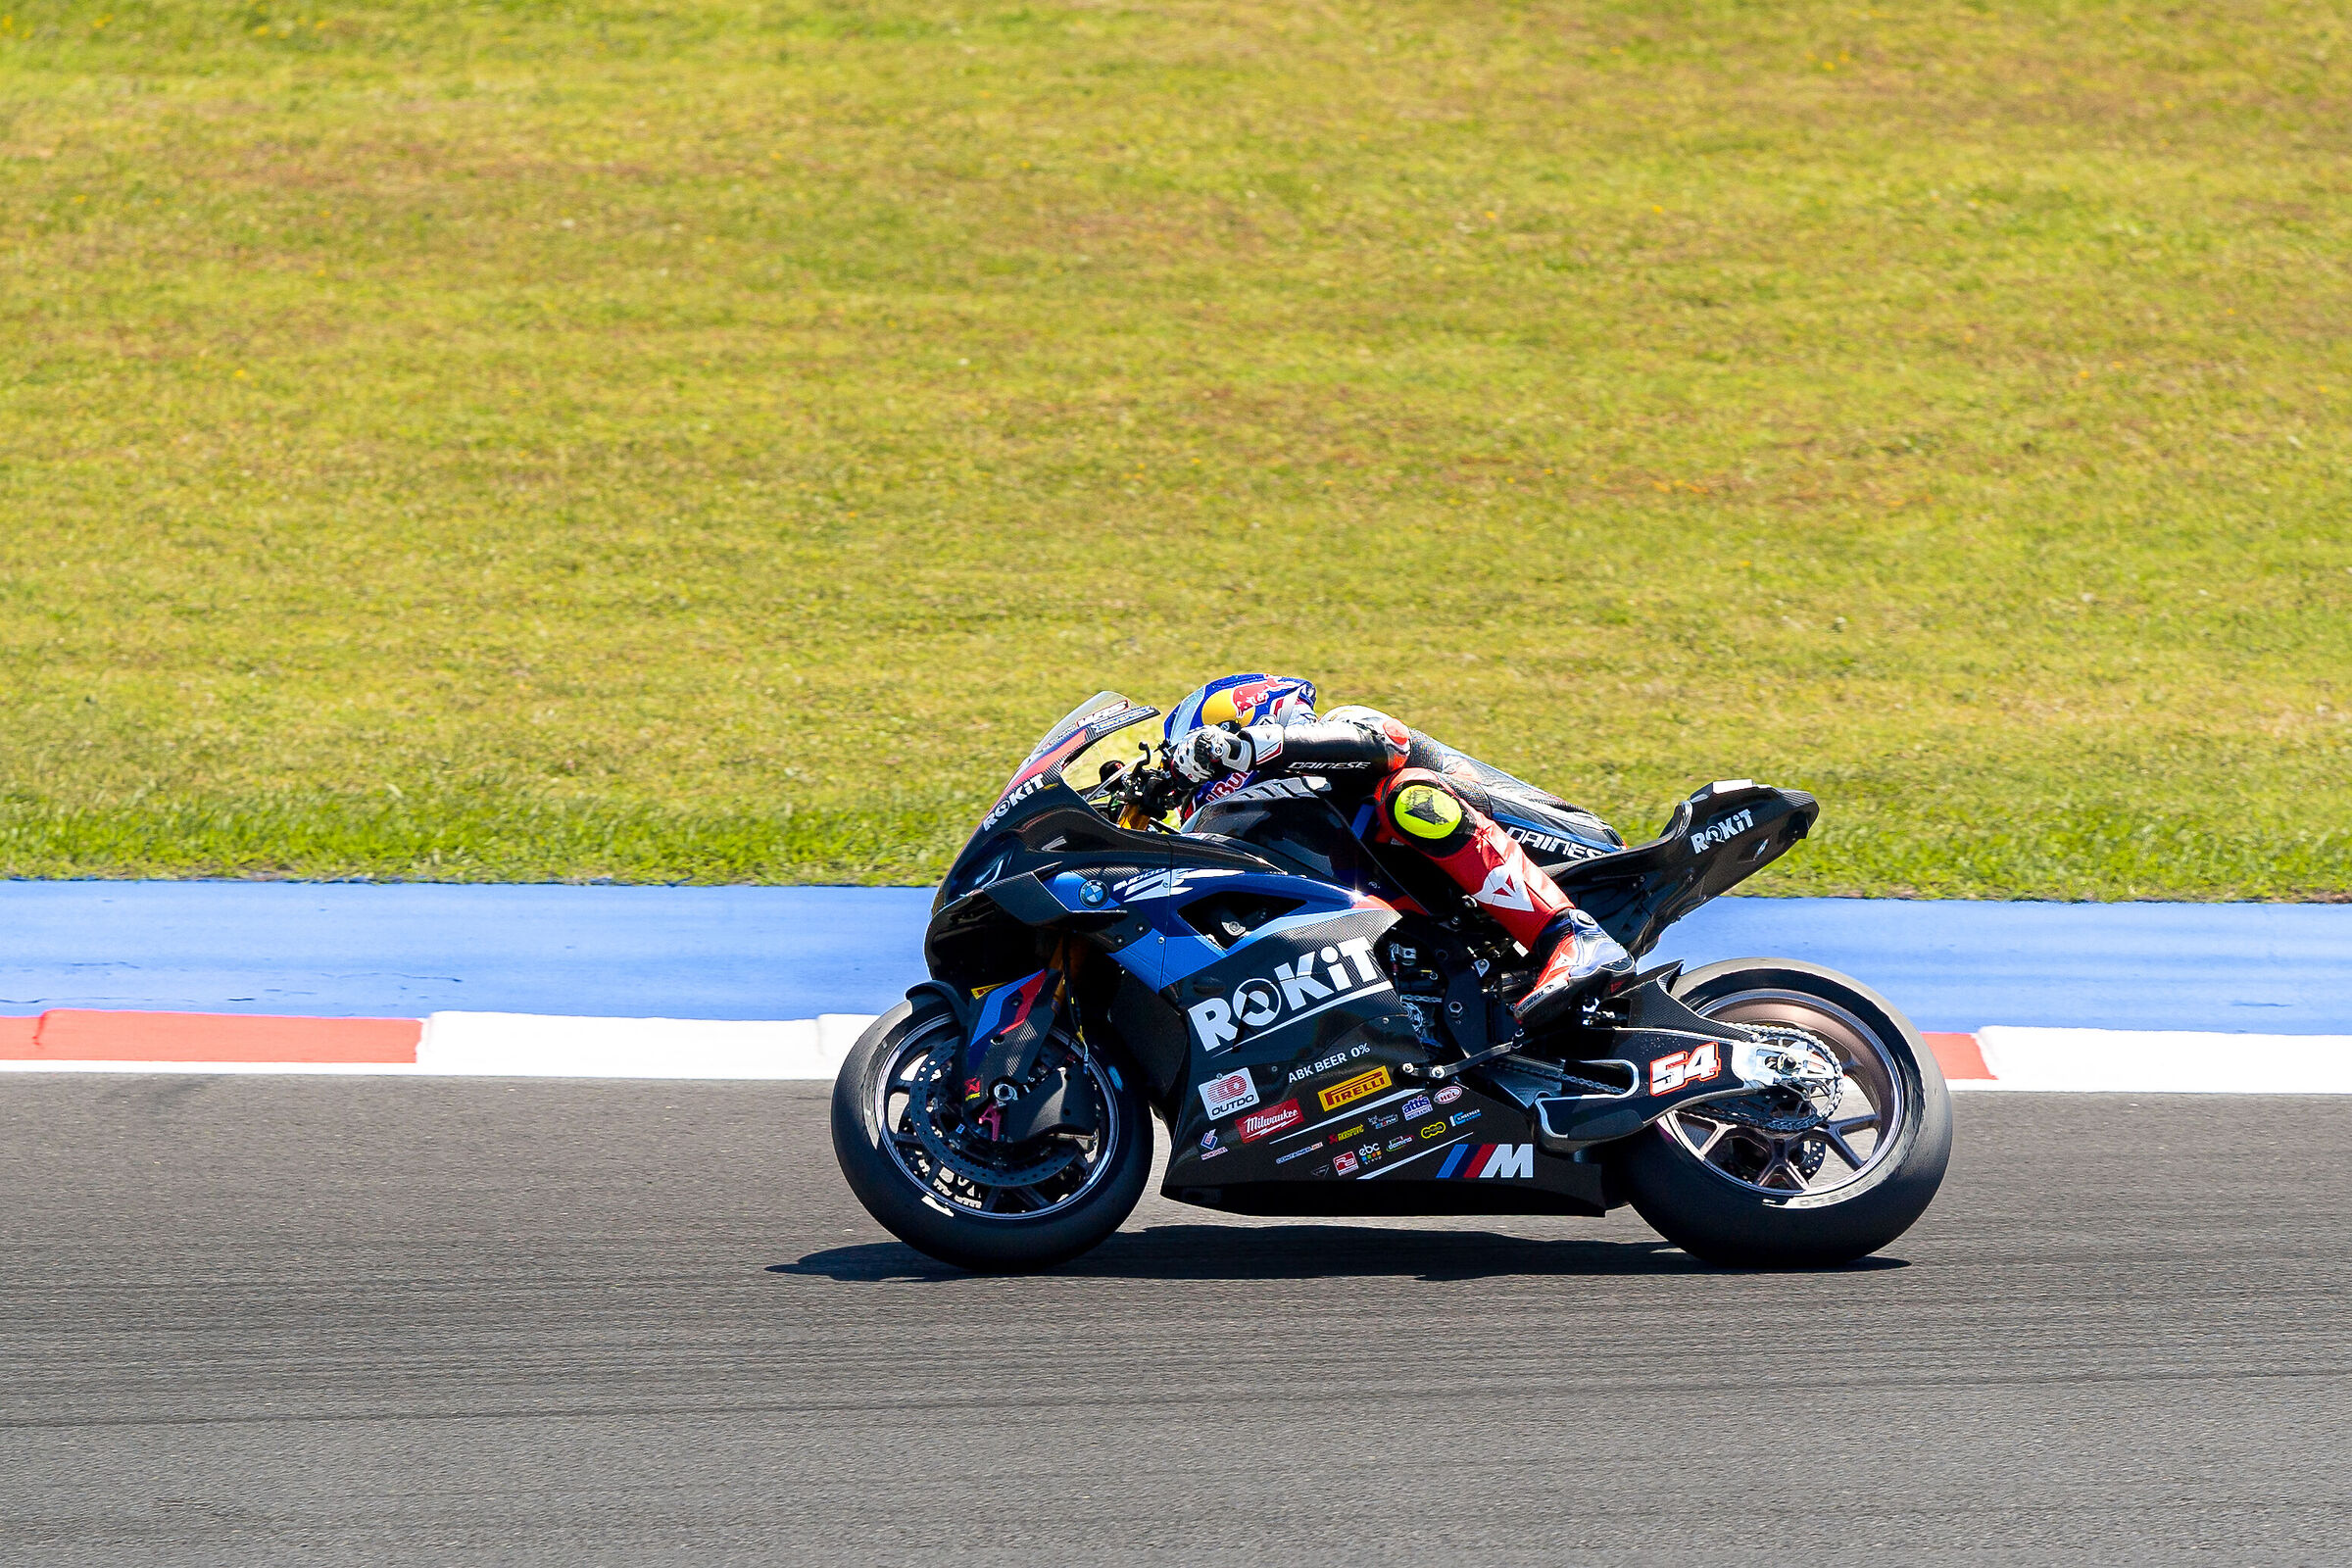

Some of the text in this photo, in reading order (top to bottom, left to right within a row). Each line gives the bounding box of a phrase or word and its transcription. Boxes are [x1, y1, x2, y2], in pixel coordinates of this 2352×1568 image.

[1507, 826, 1608, 860] DAINES
[1188, 936, 1378, 1053] ROKiT
[1289, 1043, 1371, 1083] ABK BEER 0%
[1649, 1041, 1722, 1097] 54
[1211, 1095, 1254, 1116] OUTDO
[1324, 1071, 1385, 1106] PIRELLI
[1244, 1109, 1298, 1133] Milwaukee
[1358, 1143, 1380, 1156] ebc
[1479, 1144, 1534, 1178] M
